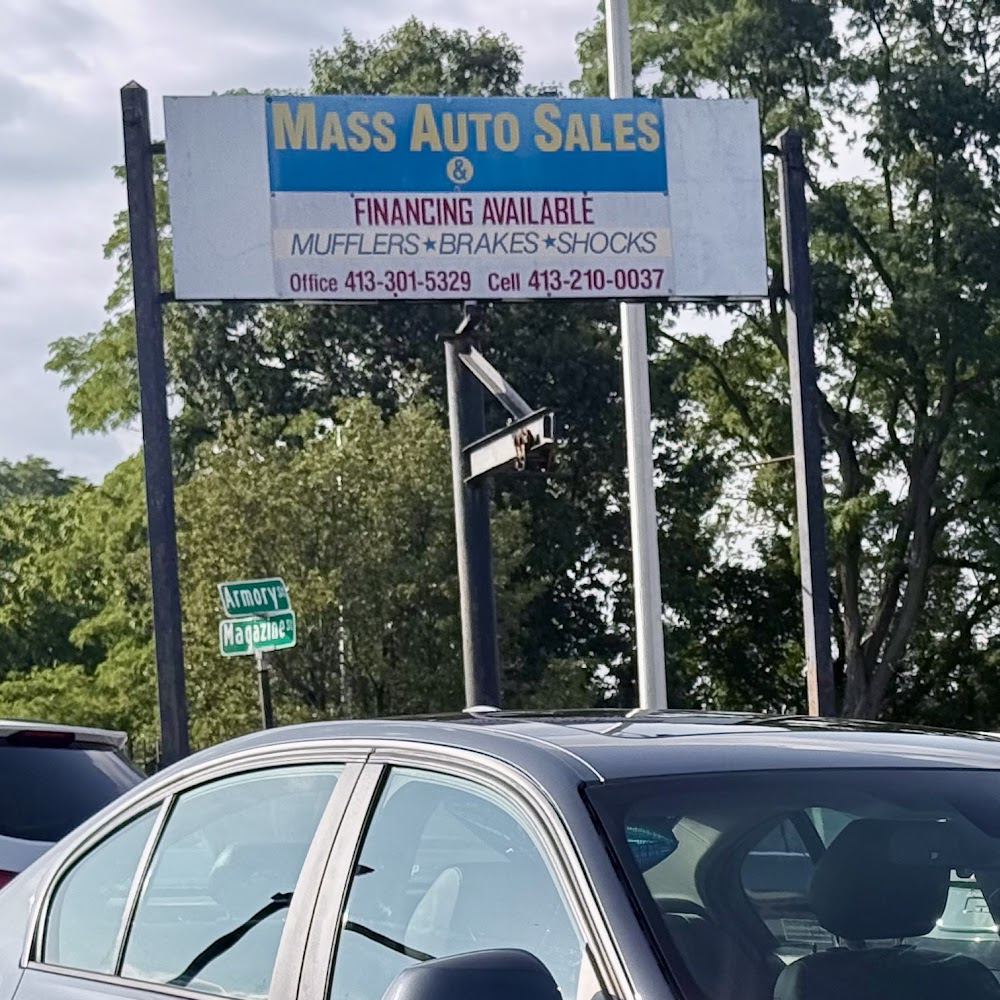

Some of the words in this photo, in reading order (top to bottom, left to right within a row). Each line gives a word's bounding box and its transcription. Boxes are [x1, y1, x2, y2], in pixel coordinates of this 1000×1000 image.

[271, 103, 396, 152] MASS
[410, 103, 520, 152] AUTO
[534, 103, 660, 152] SALES
[451, 159, 470, 182] &
[354, 197, 474, 226] FINANCING
[482, 196, 595, 225] AVAILABLE
[291, 233, 421, 256] MUFFLERS
[439, 232, 540, 255] BRAKES
[557, 231, 658, 255] SHOCKS
[290, 272, 338, 293] Office
[344, 270, 472, 293] 413-301-5329
[488, 270, 521, 292] Cell
[528, 268, 665, 292] 413-210-0037
[224, 586, 279, 609] Armory
[223, 620, 286, 649] Magazine
